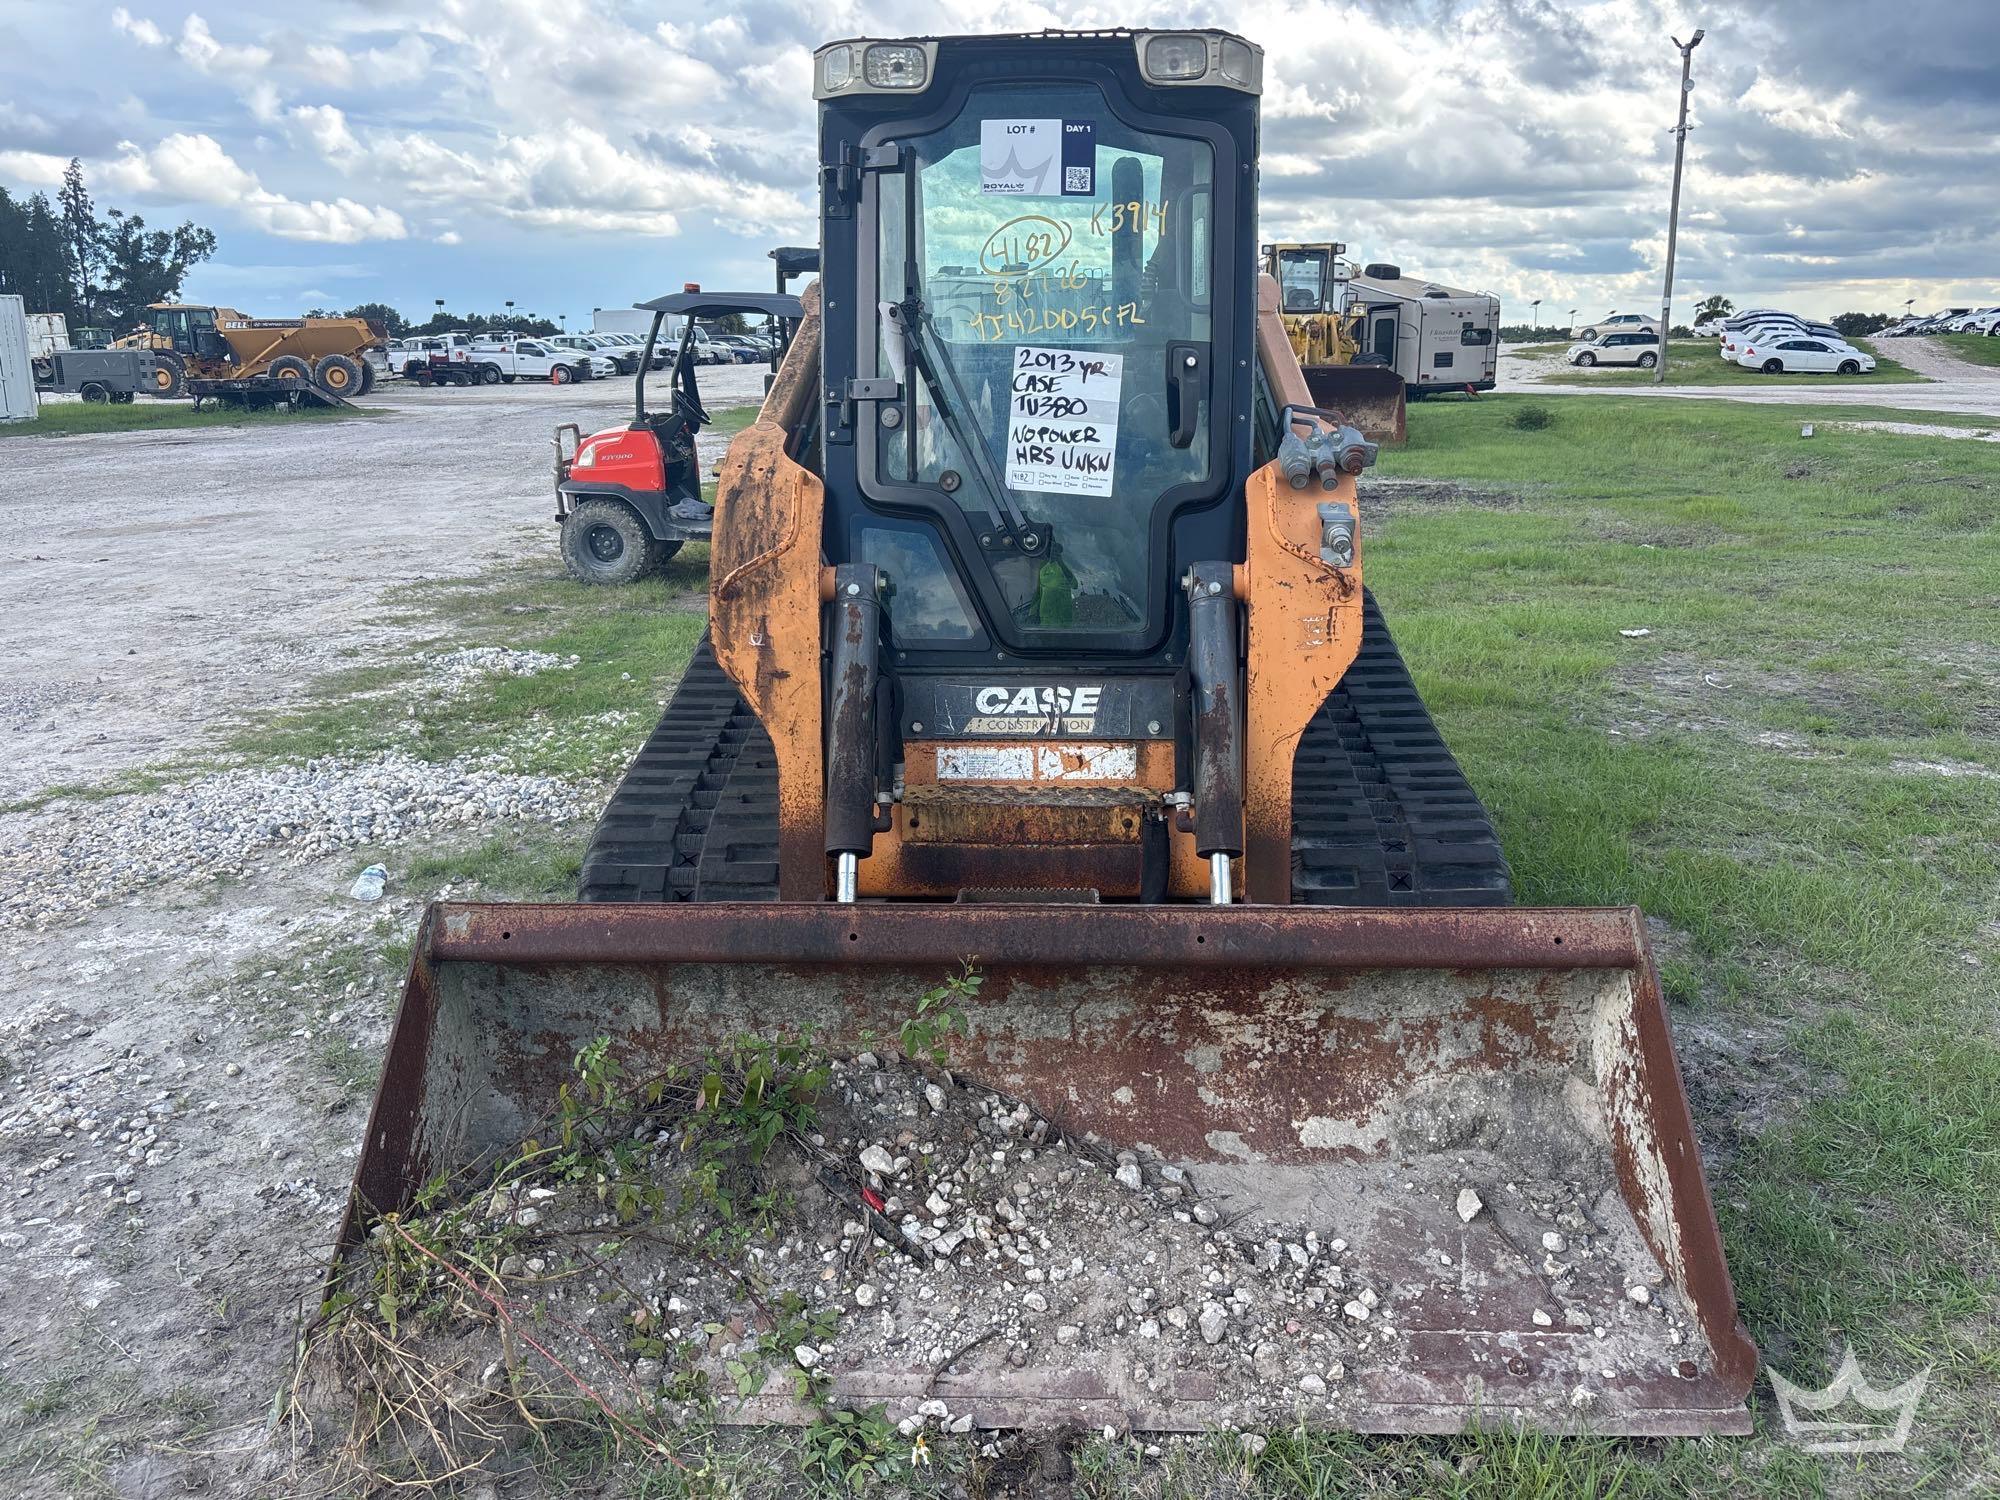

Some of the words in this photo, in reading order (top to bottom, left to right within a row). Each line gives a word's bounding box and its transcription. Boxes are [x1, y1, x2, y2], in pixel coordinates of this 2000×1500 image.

[1006, 125, 1027, 134] LOT
[1029, 125, 1036, 134] #
[1065, 124, 1085, 133] DAY
[1086, 125, 1091, 133] 1
[1091, 200, 1168, 236] K3914
[991, 232, 1051, 266] 4182
[225, 321, 247, 329] BELL
[1019, 349, 1075, 373] 2013
[1012, 373, 1071, 393] CASE
[1016, 445, 1055, 465] HRS
[1062, 446, 1111, 474] UNKN
[975, 687, 1102, 714] CASE
